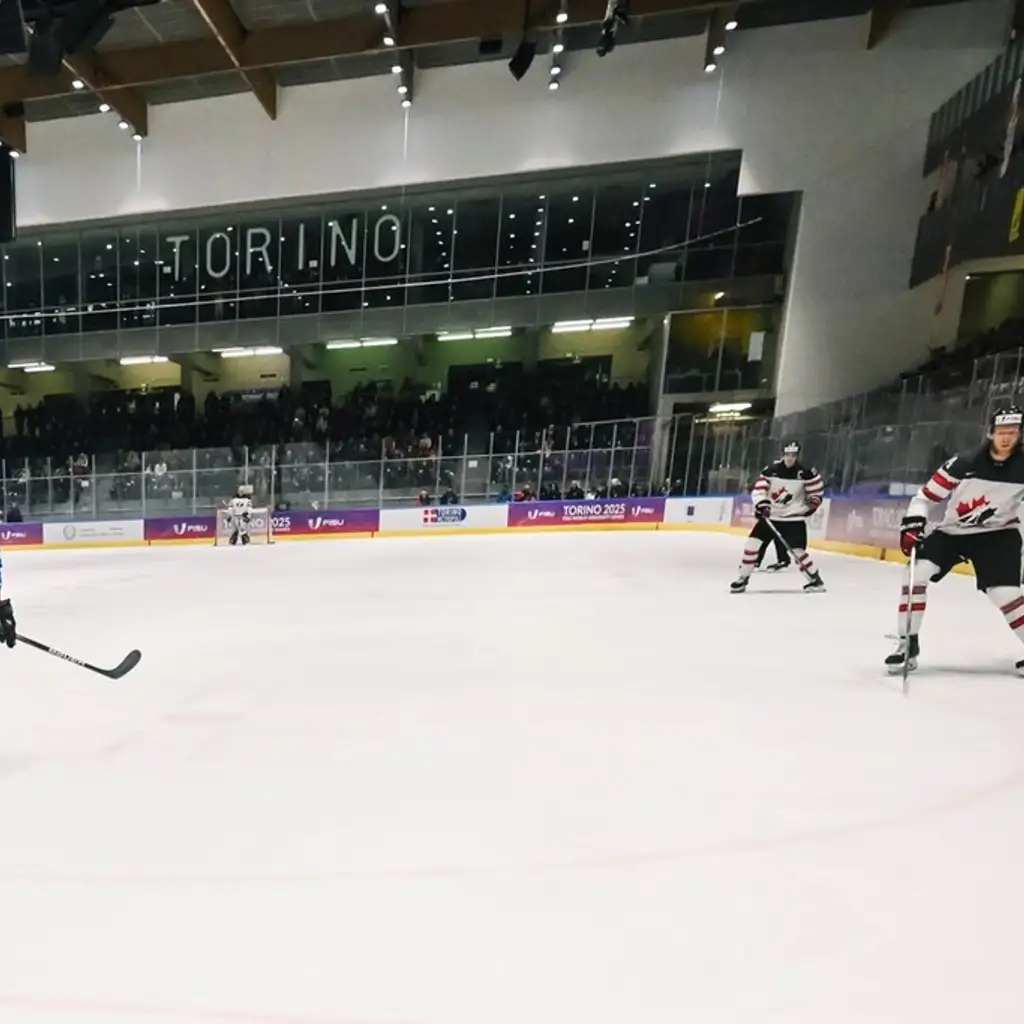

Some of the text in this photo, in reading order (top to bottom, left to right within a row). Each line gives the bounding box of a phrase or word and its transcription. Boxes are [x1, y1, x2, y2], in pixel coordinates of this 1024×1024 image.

[166, 214, 400, 282] TORINO
[563, 504, 625, 516] TORINO 2025
